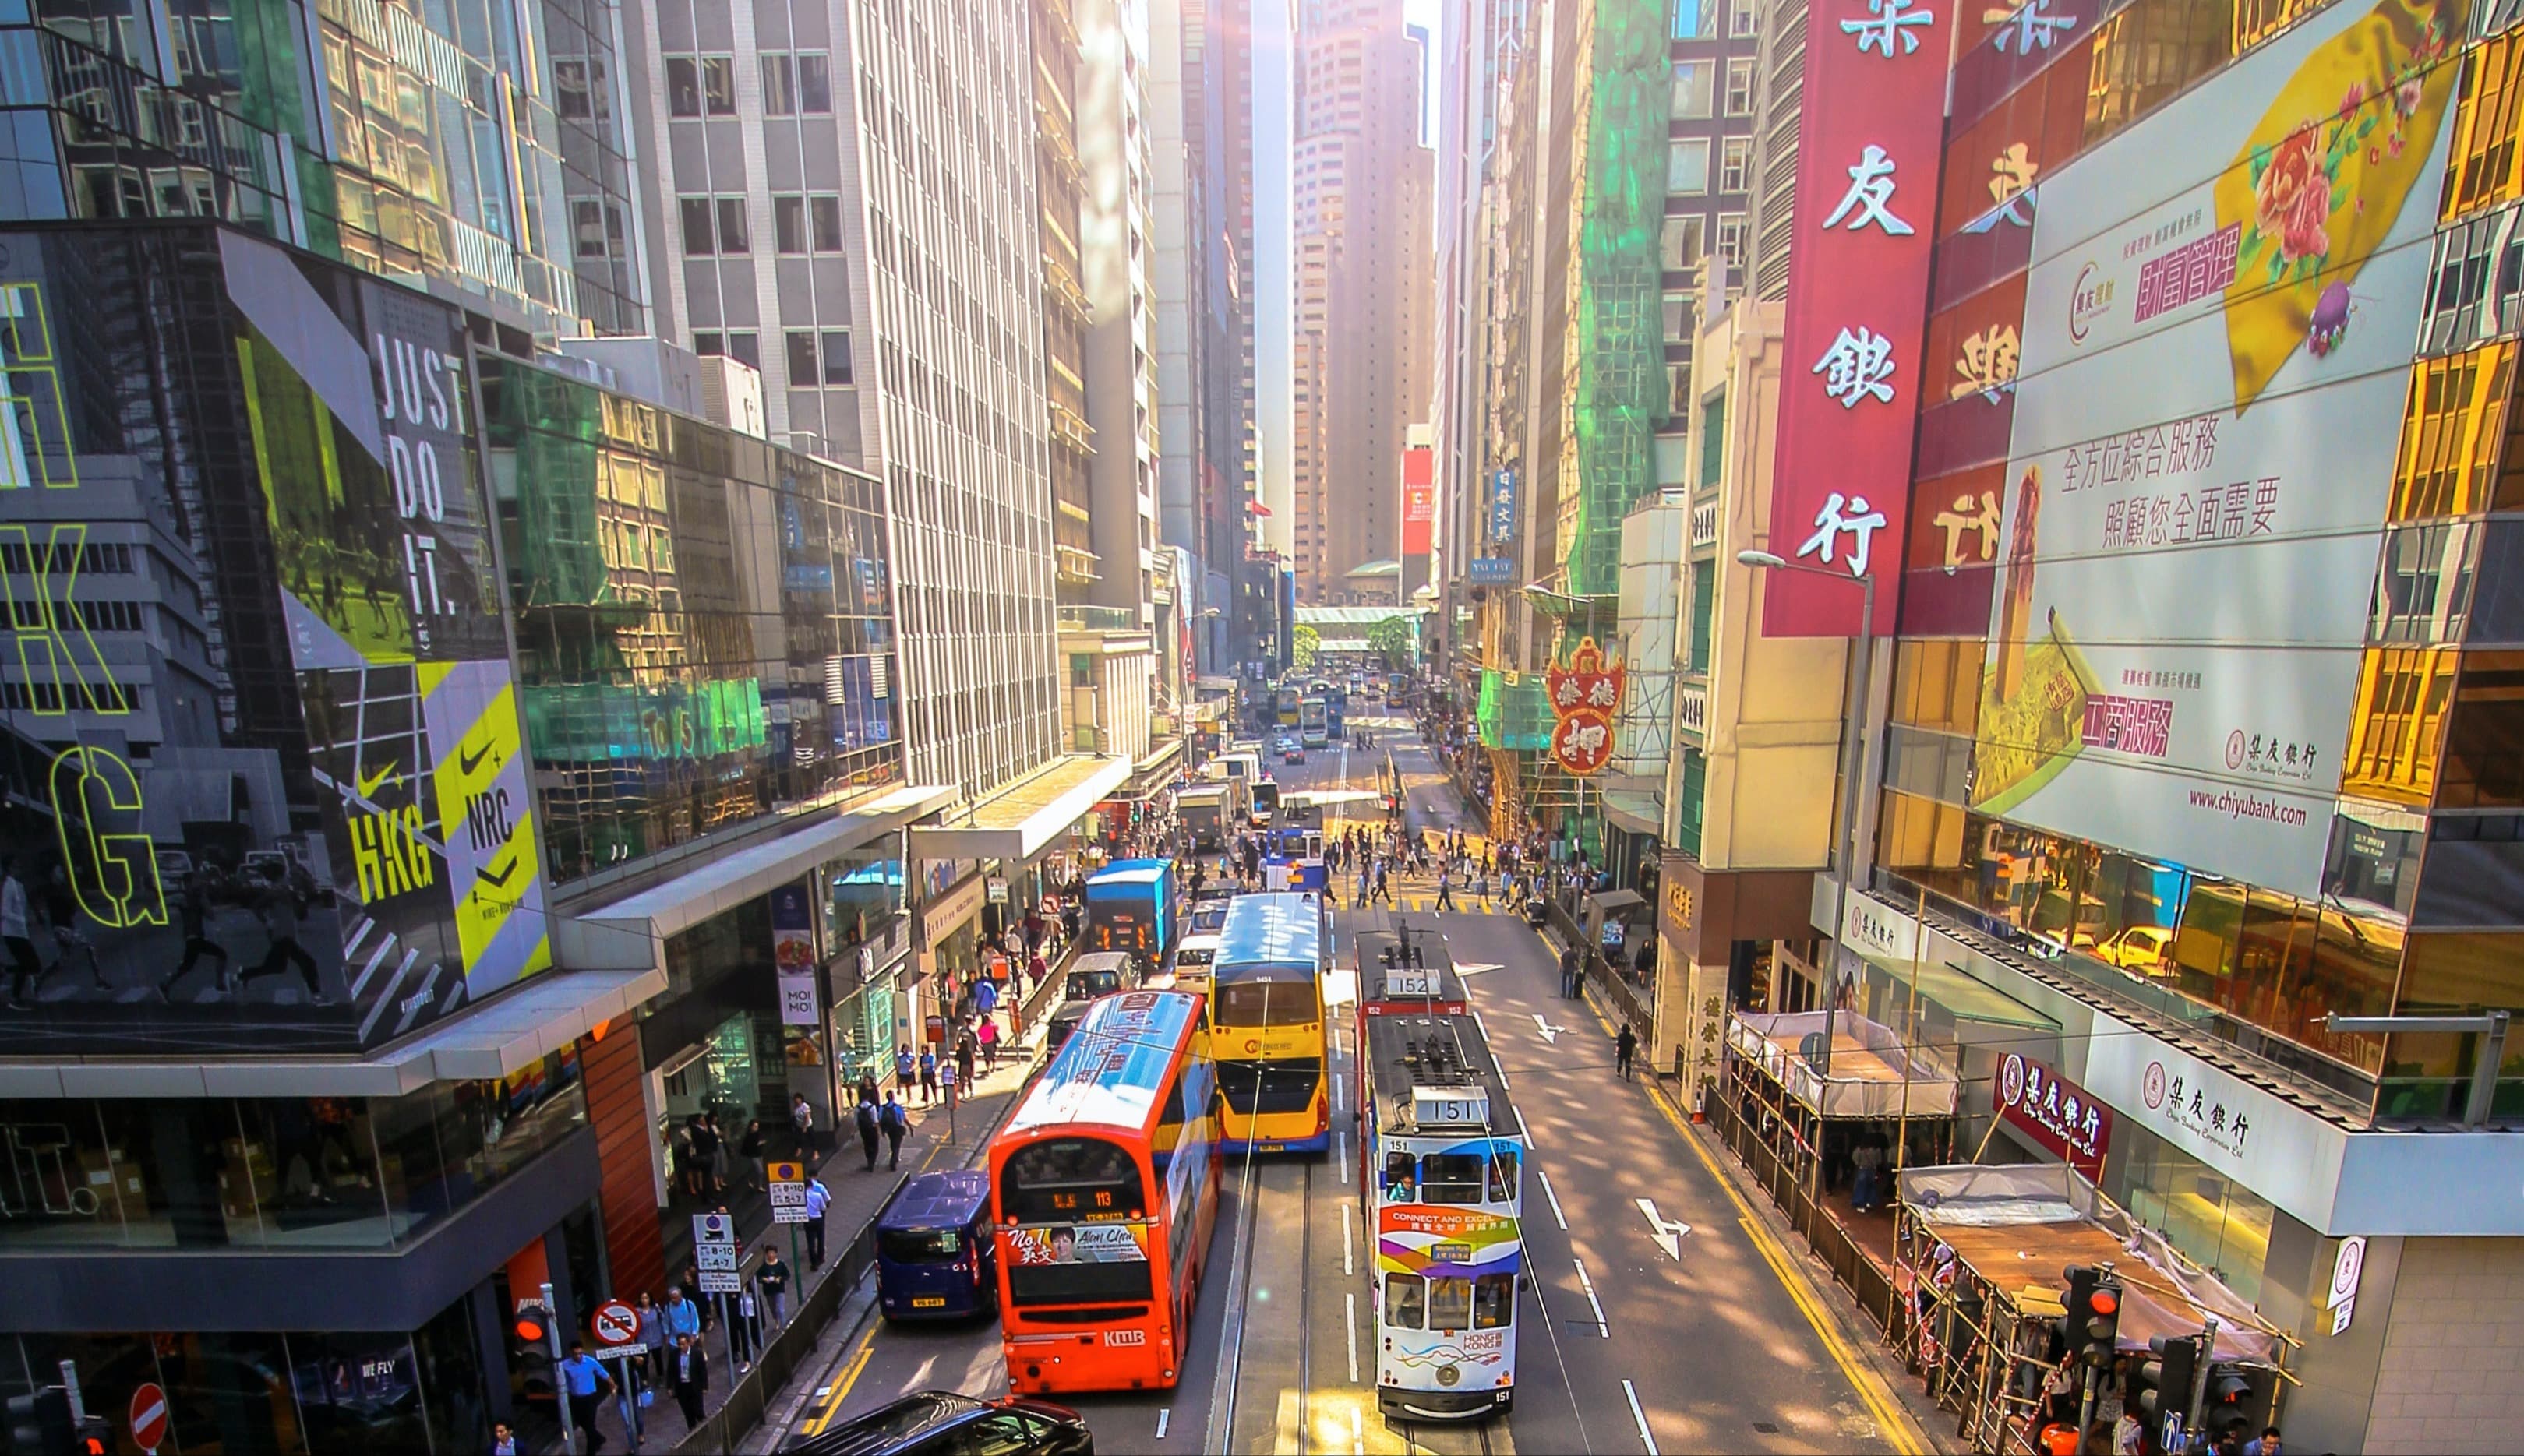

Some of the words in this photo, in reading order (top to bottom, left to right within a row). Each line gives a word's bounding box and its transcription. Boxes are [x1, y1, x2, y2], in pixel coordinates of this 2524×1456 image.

[2136, 226, 2240, 322] 財富管理
[377, 333, 466, 435] JUST
[2062, 414, 2220, 492] 全方位綜合服務
[389, 435, 444, 524] DO
[2102, 477, 2281, 548] 照顧您全面需要
[2081, 698, 2173, 757] 工商服務
[1561, 718, 1607, 766] 押
[2248, 733, 2317, 770] 集友銀行
[2189, 789, 2307, 827] www.chiyubank.com
[465, 788, 514, 851] NRC
[348, 803, 434, 905] HKG
[1399, 978, 1429, 993] 152
[787, 990, 811, 1001] MOI
[789, 1002, 812, 1013] MOI
[1449, 1006, 1461, 1014] 152
[1434, 1101, 1472, 1120] 151
[2025, 1066, 2100, 1144] 集友銀行
[2169, 1075, 2249, 1147] 集友銀行
[1389, 1140, 1407, 1151] 151
[1495, 1140, 1512, 1151] 151
[783, 1183, 803, 1192] 8-10
[1095, 1191, 1112, 1207] 113
[1393, 1212, 1439, 1223] CONNECT
[1440, 1215, 1462, 1224] AND
[1464, 1215, 1495, 1223] EXCEL
[1008, 1228, 1045, 1248] No.1
[711, 1246, 734, 1256] 8-10
[1019, 1246, 1056, 1264] 英文
[713, 1258, 729, 1267] 4-7
[1103, 1330, 1146, 1347] KMB
[1464, 1333, 1495, 1342] HONG
[1464, 1341, 1495, 1351] KONG
[362, 1363, 376, 1378] WE
[377, 1359, 396, 1376] FLY
[1495, 1390, 1510, 1402] 151
